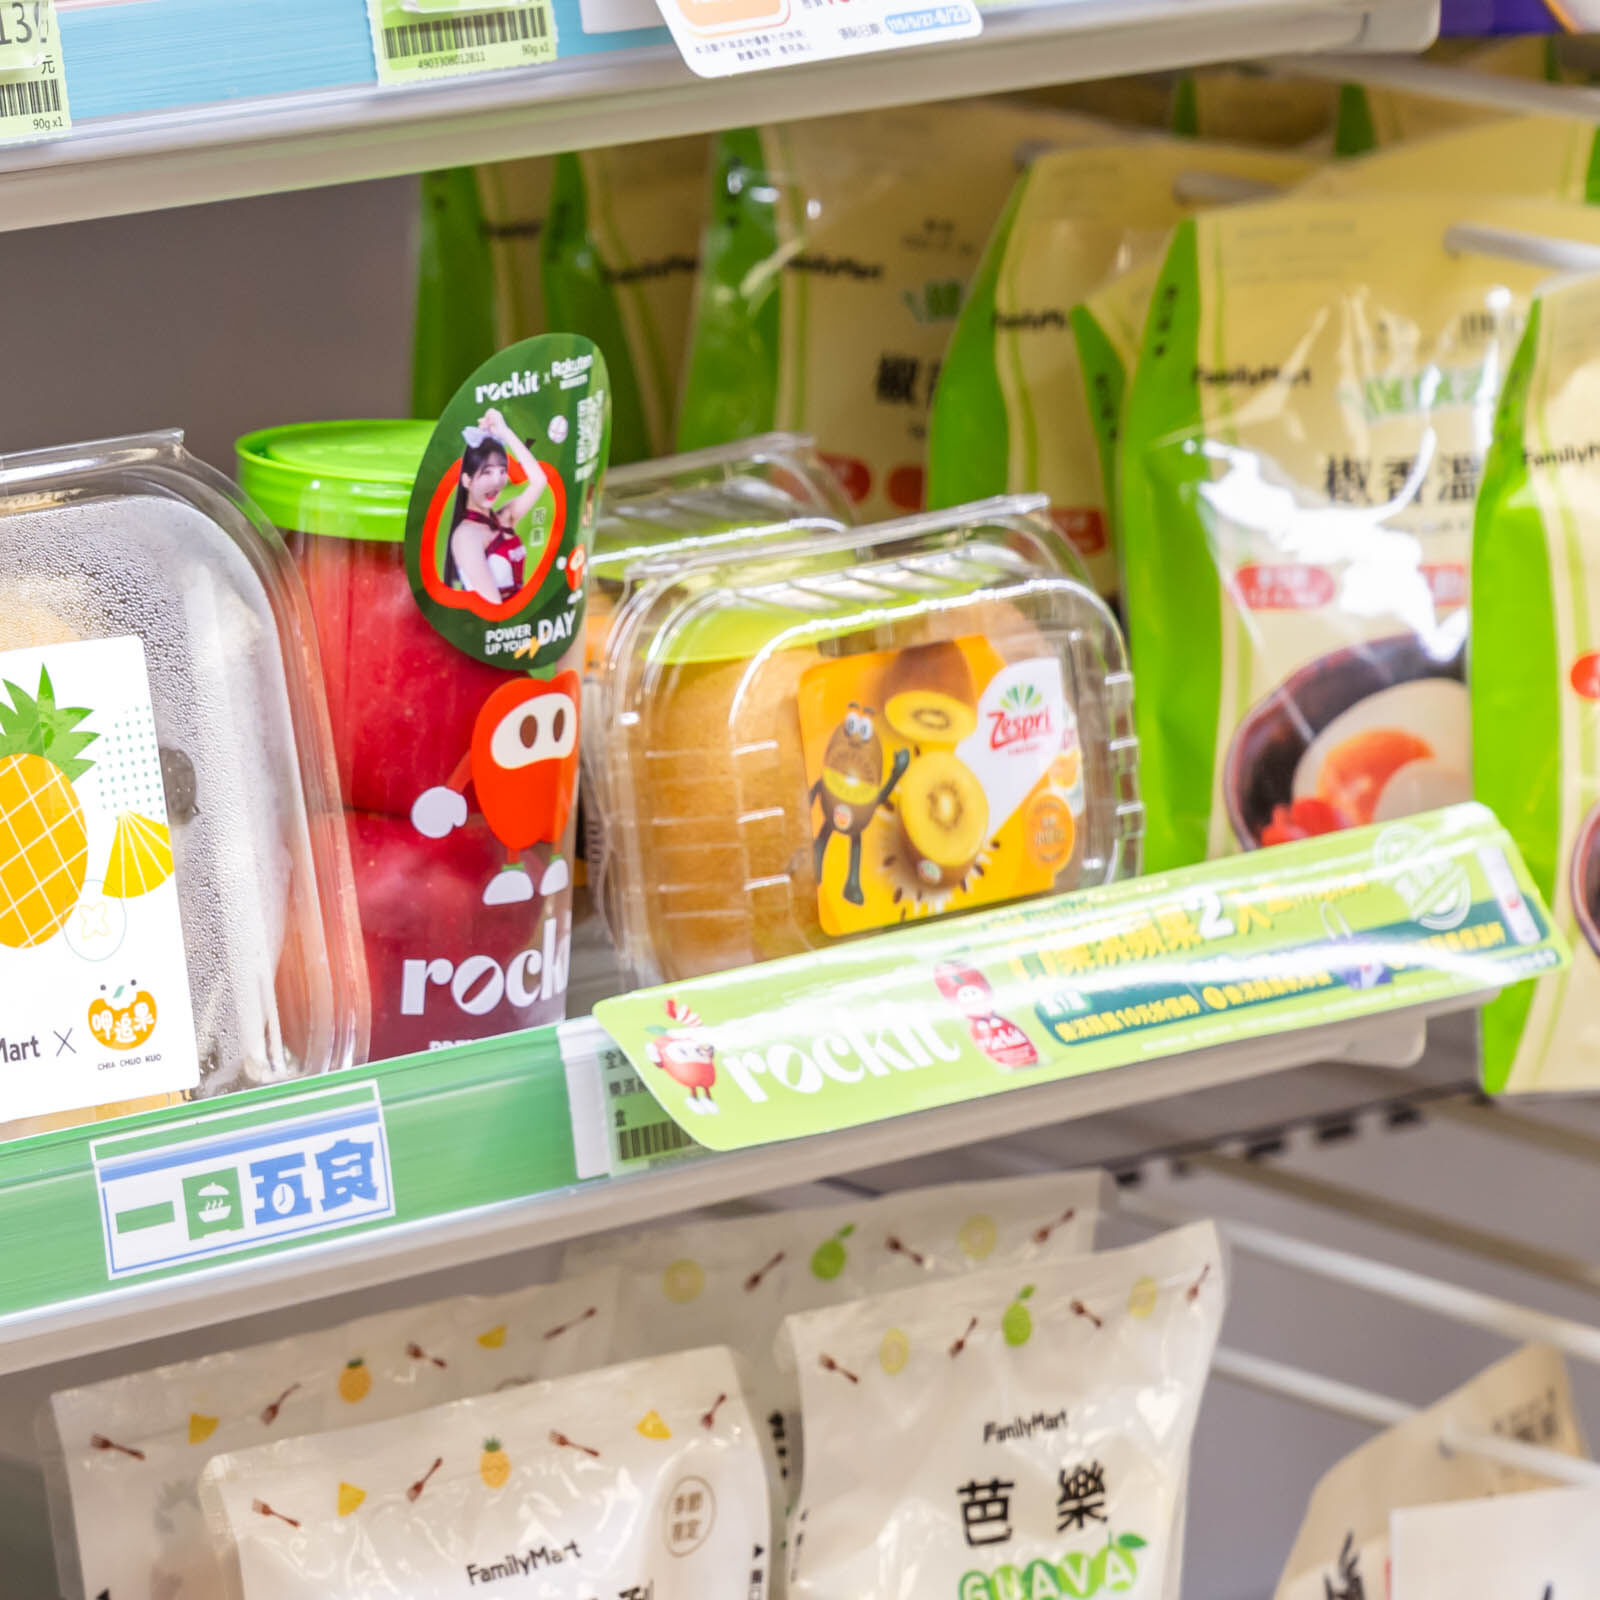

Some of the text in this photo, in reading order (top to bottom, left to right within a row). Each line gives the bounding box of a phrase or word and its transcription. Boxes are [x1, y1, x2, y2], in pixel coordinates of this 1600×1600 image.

[41, 54, 55, 75] 元
[33, 117, 51, 131] 90g
[475, 354, 593, 403] rockit Rakuten
[484, 611, 576, 656] UP YOUR DAY
[485, 624, 531, 640] POWER
[988, 709, 1050, 750] Zespri
[97, 1053, 162, 1071] CHIA KUO
[115, 1138, 379, 1240] 一日五食
[983, 1408, 1068, 1444] FamilyMart
[957, 1460, 1109, 1549] 芭樂
